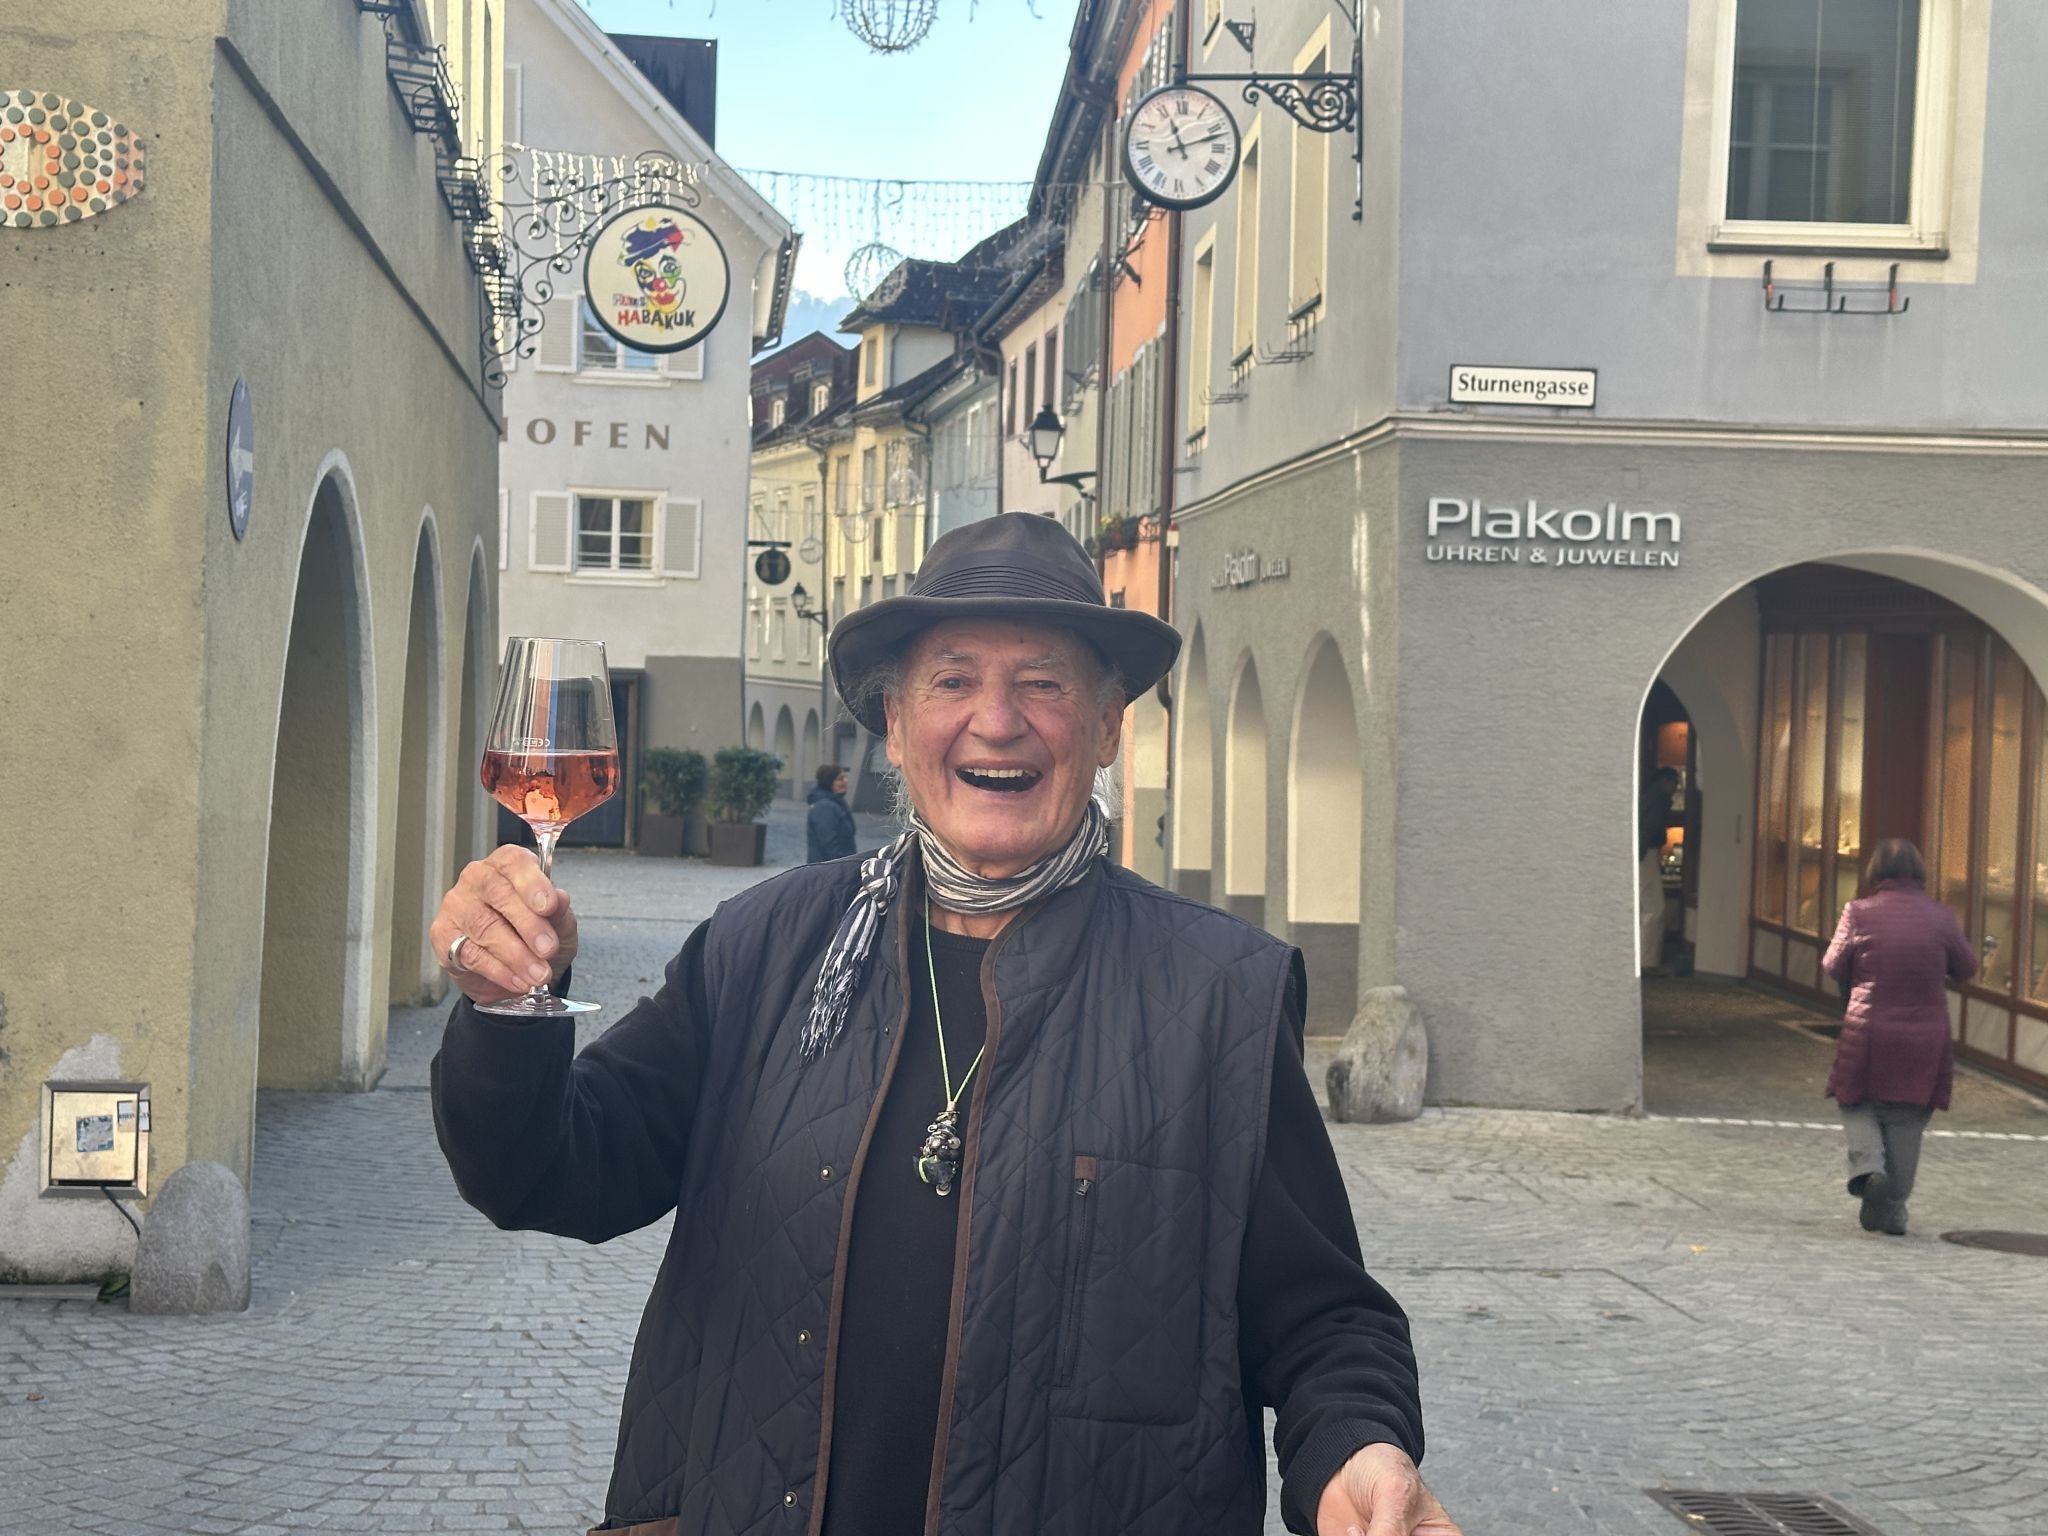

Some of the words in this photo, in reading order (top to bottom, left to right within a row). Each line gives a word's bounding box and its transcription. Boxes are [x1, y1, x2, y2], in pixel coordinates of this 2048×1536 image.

[618, 309, 696, 330] HABAKUK
[1457, 372, 1589, 400] Sturnengasse
[1427, 497, 1681, 543] Plakolm
[1426, 544, 1520, 563] UHREN
[1529, 546, 1548, 564] &
[1555, 547, 1680, 567] JUWELEN
